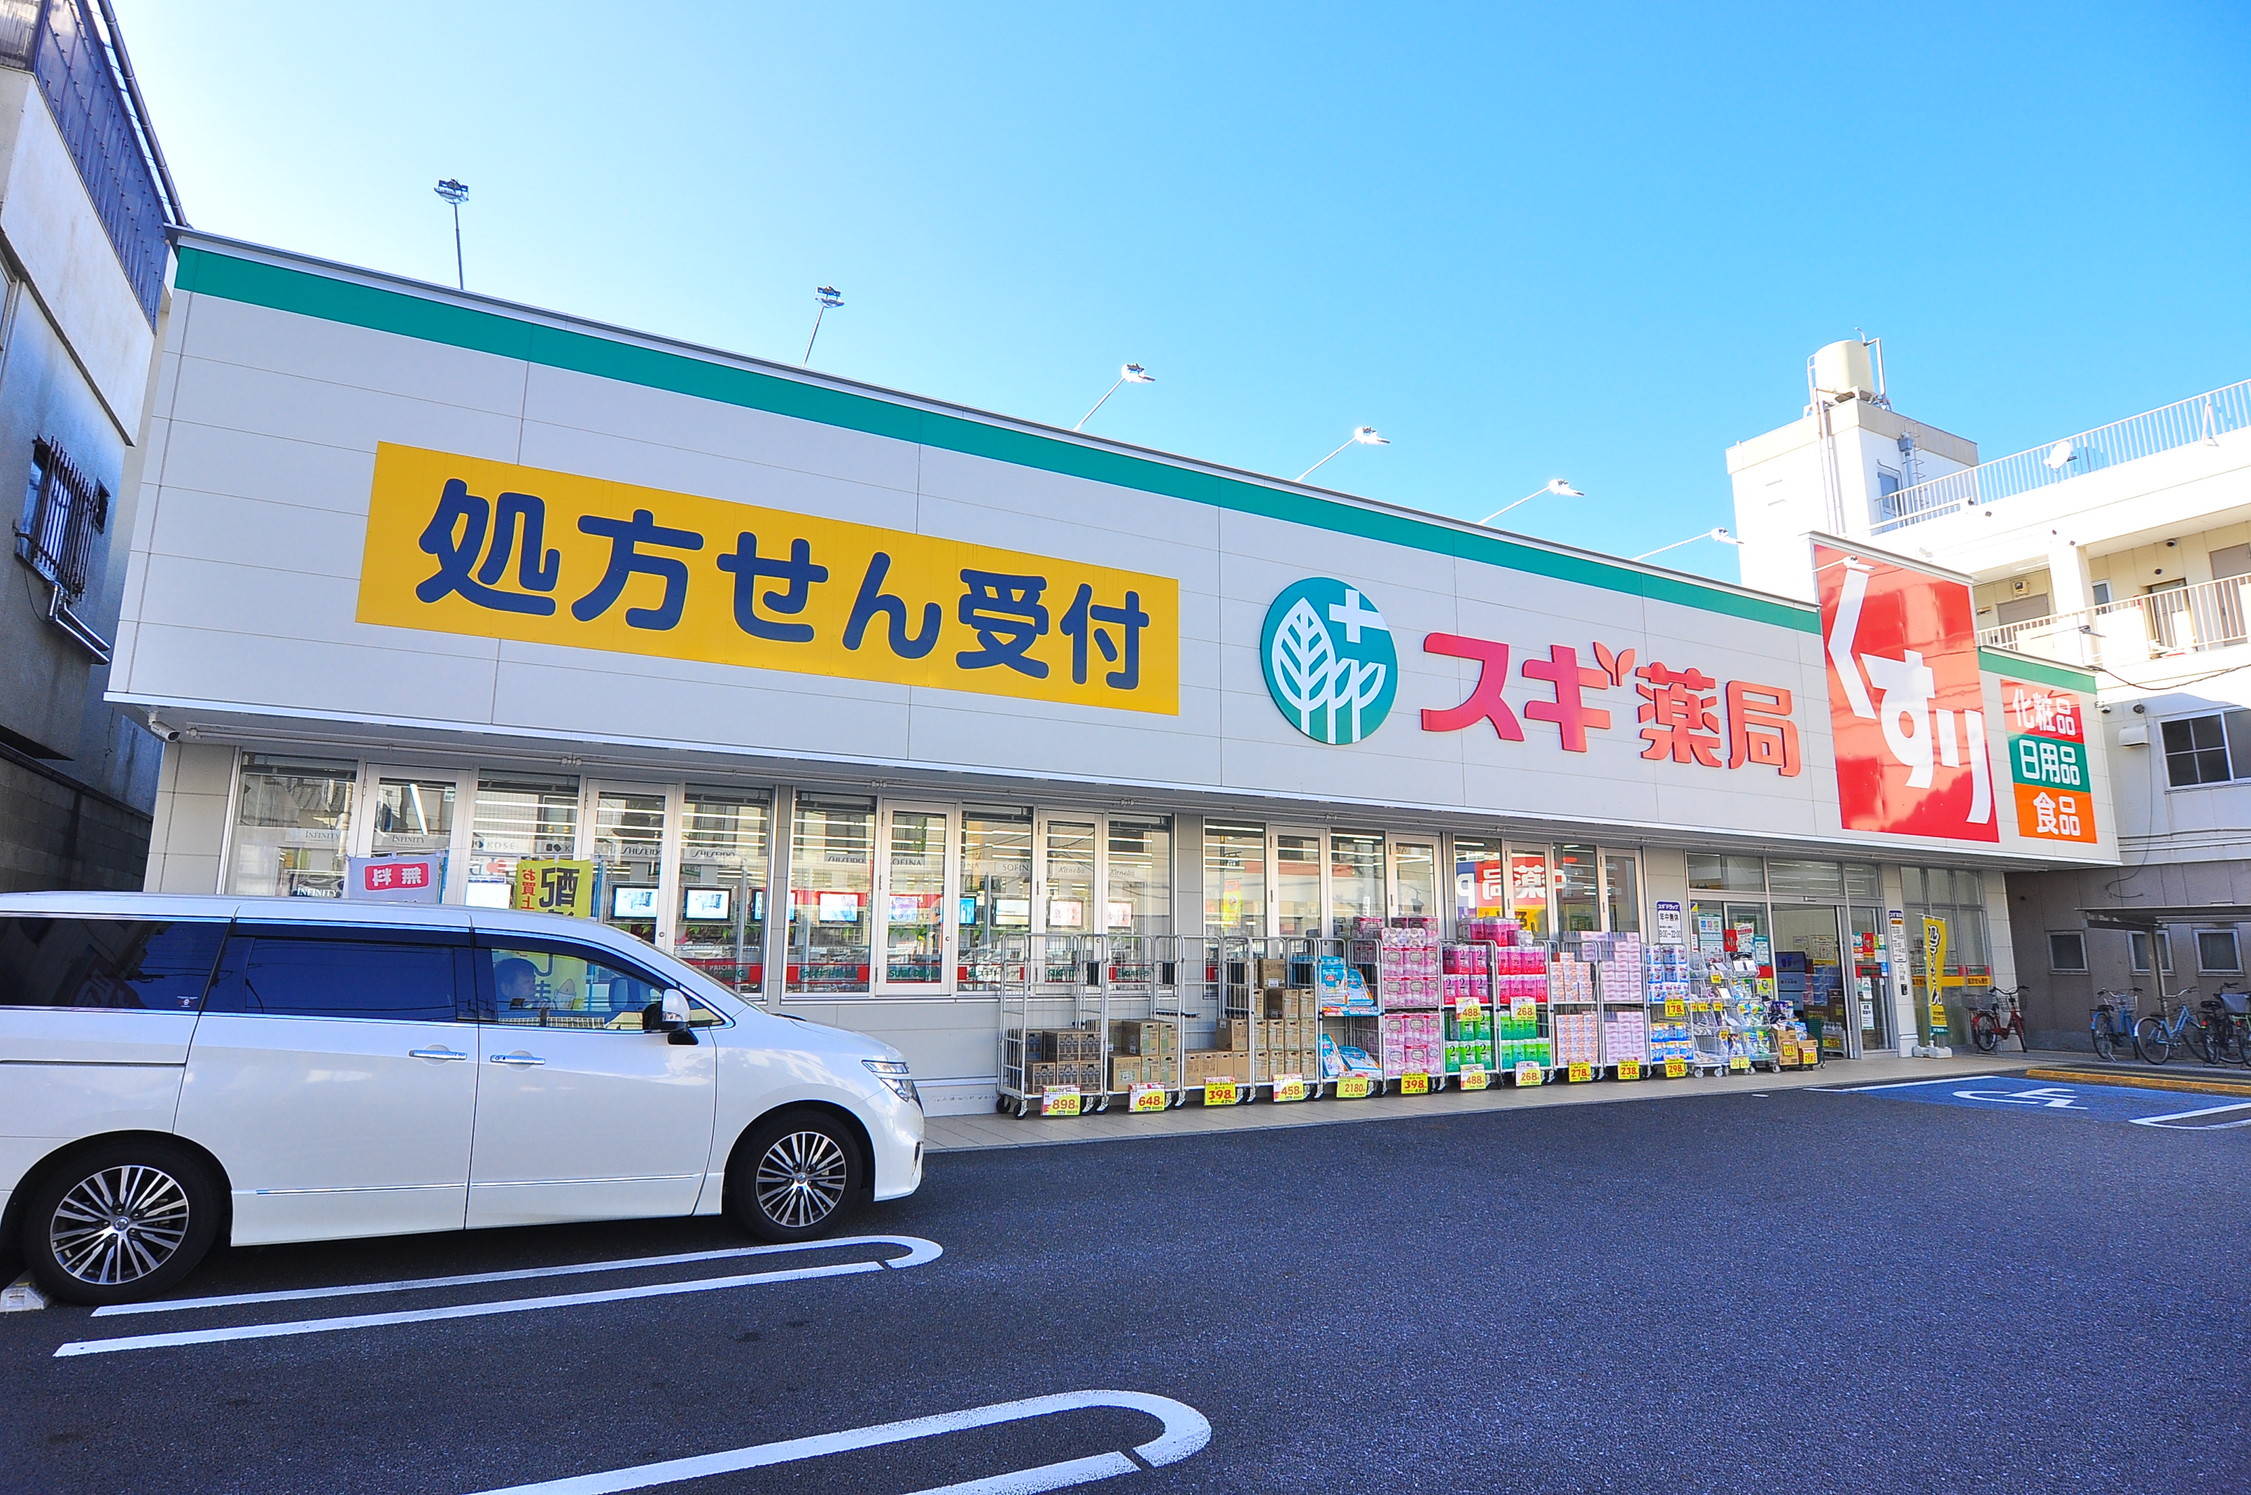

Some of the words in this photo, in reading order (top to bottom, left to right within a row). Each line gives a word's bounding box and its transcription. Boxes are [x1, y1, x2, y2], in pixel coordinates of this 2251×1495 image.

[416, 478, 1150, 690] 処方せん受付
[1421, 632, 1801, 777] スギ薬局
[1828, 569, 1992, 824] くすり
[2012, 688, 2076, 736] 化粧品
[2018, 739, 2081, 786] 日用品
[2032, 791, 2081, 836] 食品
[621, 847, 660, 855] SHISEID
[892, 857, 922, 866] OFINA
[1003, 863, 1031, 872] SOFIN
[297, 887, 338, 898] INFINITY
